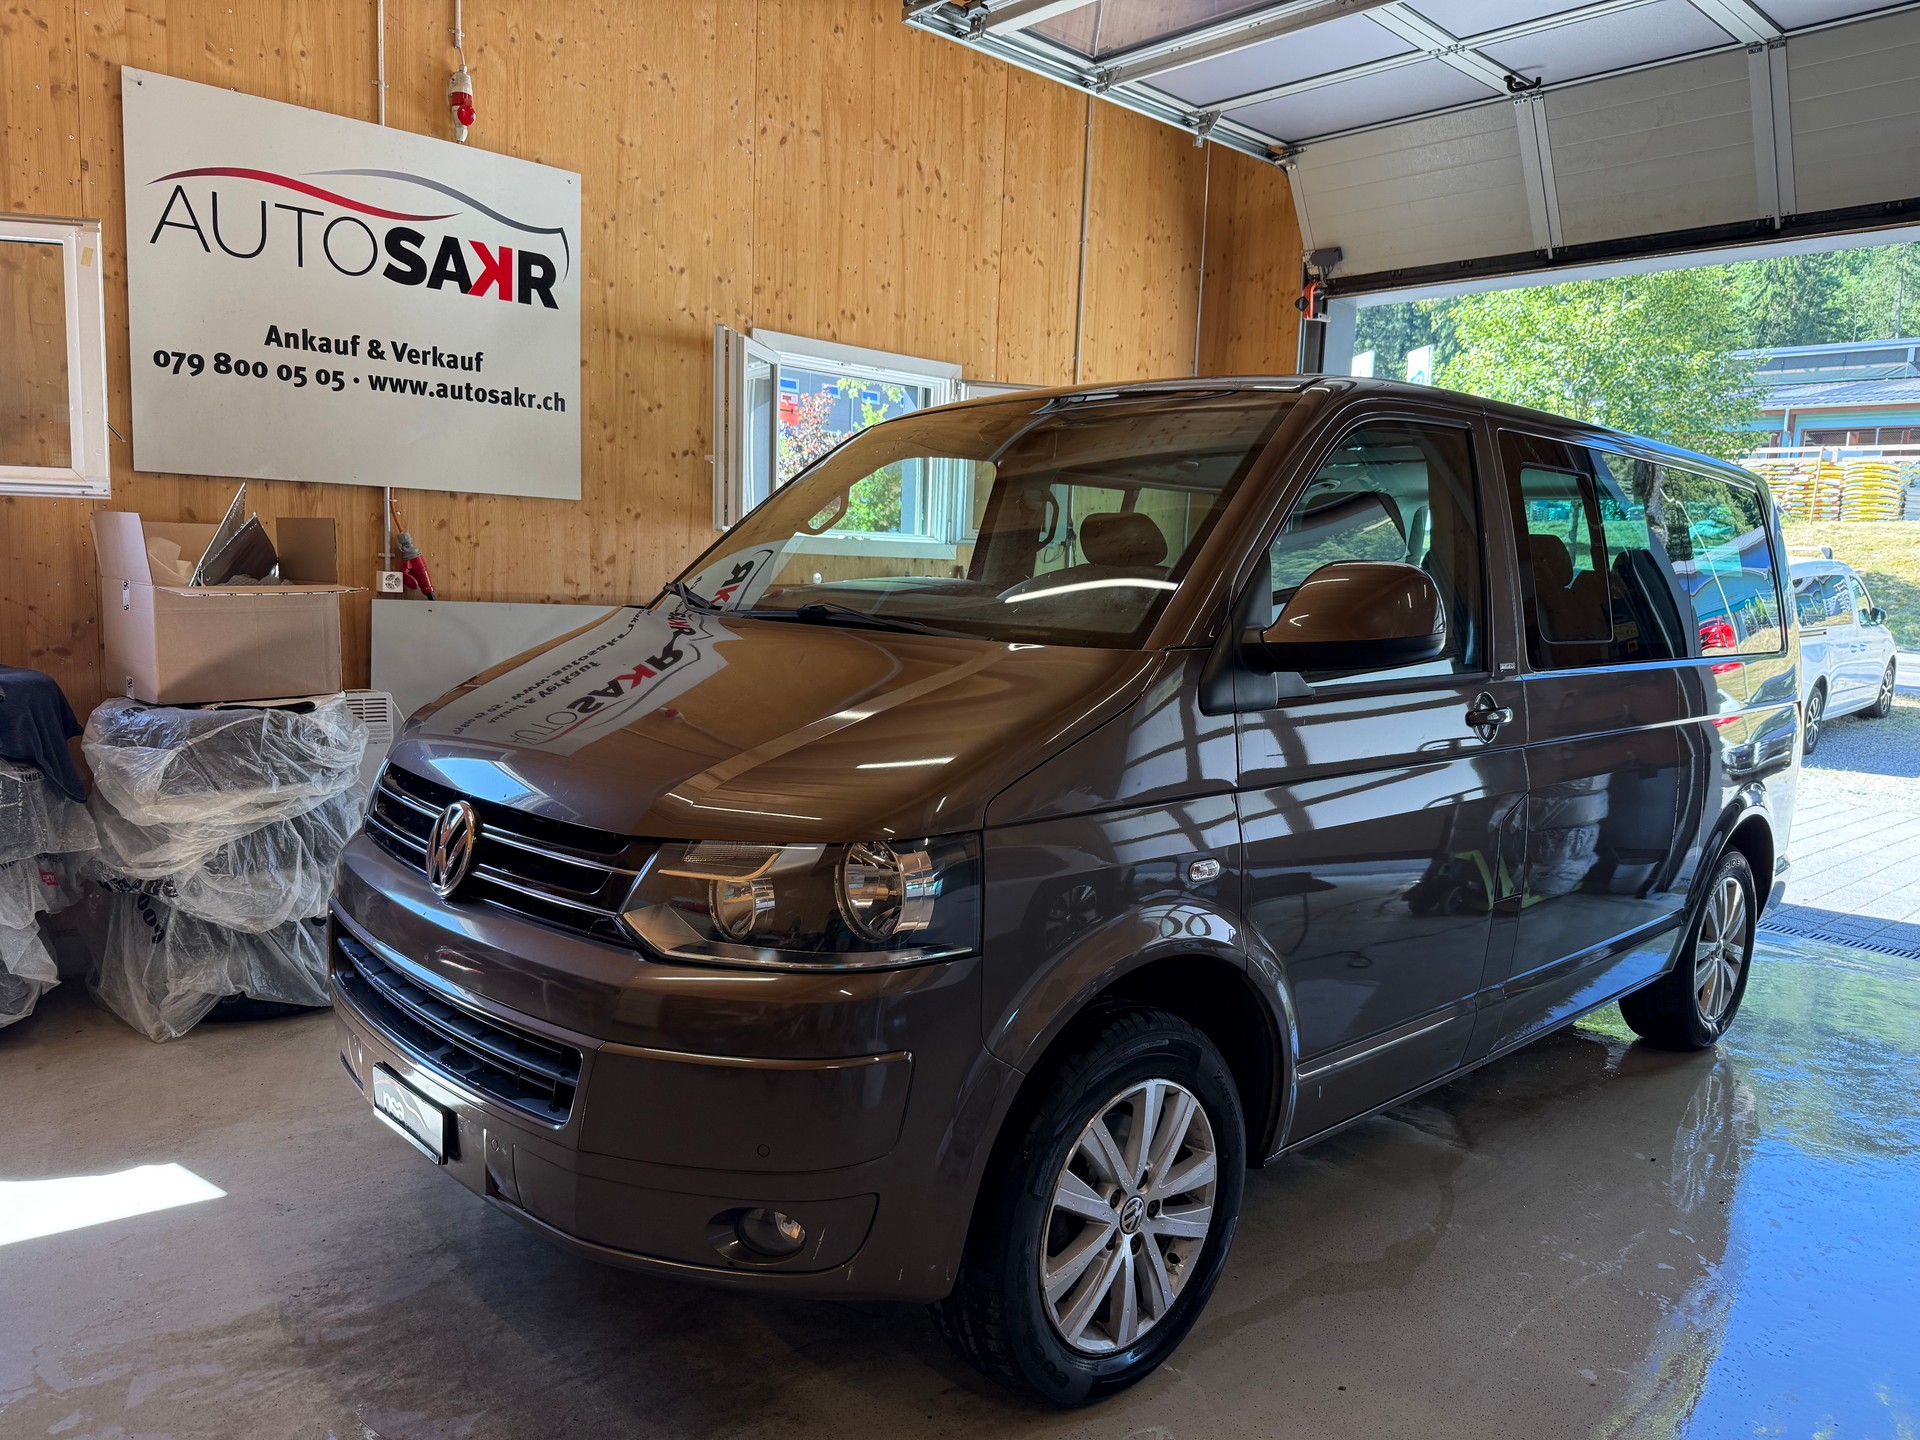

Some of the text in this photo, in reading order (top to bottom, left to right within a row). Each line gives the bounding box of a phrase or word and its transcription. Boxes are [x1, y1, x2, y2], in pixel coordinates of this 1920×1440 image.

[264, 325, 484, 372] Ankauf & Verkauf
[153, 350, 566, 412] 079 800 05 05 www.autosakr.ch
